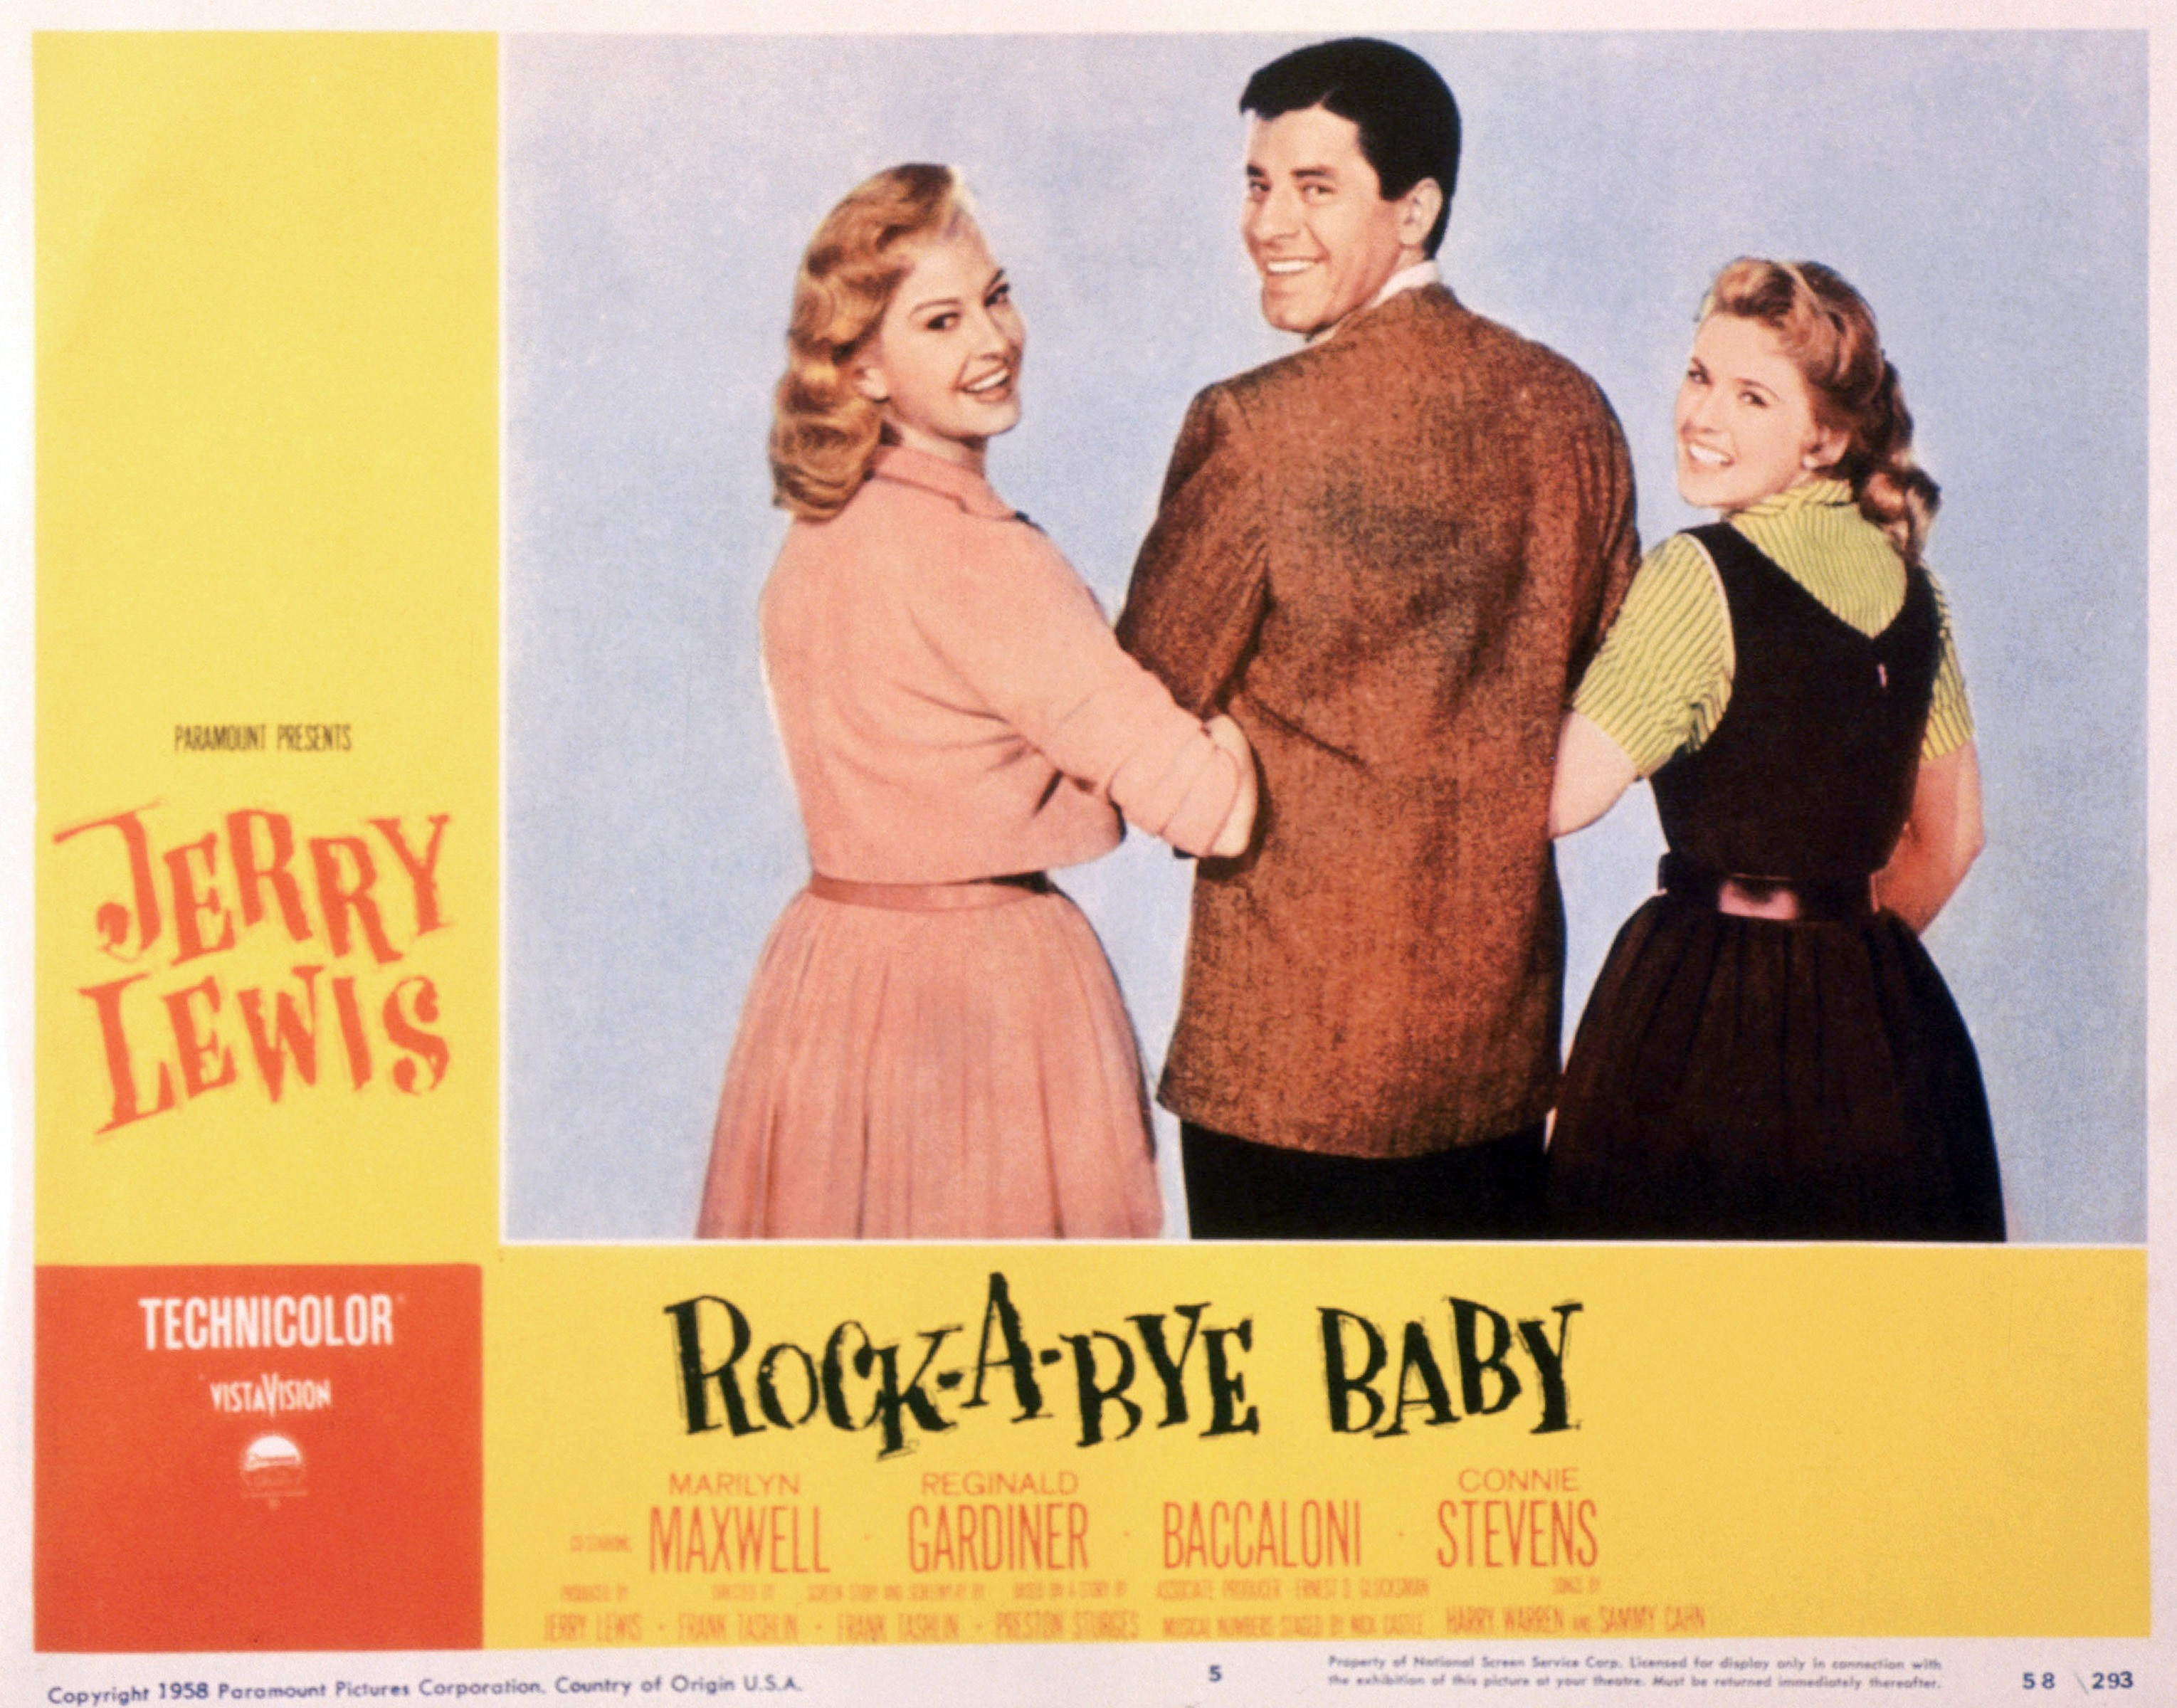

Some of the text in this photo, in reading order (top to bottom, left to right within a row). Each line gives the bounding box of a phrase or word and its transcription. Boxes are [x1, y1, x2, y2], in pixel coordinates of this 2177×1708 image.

[174, 723, 353, 752] PARAMOUNT PRESENTS
[52, 797, 455, 967] JERRY
[77, 964, 451, 1136] LEWIS
[138, 1292, 394, 1351] TECHNICOLOR
[663, 1270, 1584, 1461] ROCK-A-BYE BABY
[668, 1471, 802, 1497] MARILYN
[920, 1469, 1080, 1497] REGINALD
[1457, 1466, 1581, 1494] CONNIE
[648, 1504, 831, 1574] MAXWELL
[907, 1499, 1090, 1574] GARDINER
[1162, 1498, 1362, 1571] BACCALONI
[1435, 1498, 1599, 1569] STEVENS
[542, 1612, 643, 1643] JERRY LEWIS
[678, 1613, 727, 1641] FRANK
[836, 1613, 887, 1642] FRANK
[995, 1610, 1066, 1640] PRESTON
[1445, 1606, 1495, 1634] HARRY
[1502, 1606, 1566, 1633] WARREN
[1598, 1606, 1657, 1633] SAMMY
[1663, 1605, 1707, 1633] CAHN
[1208, 1664, 1223, 1683] 5
[1327, 1655, 1943, 1672] Property of National Screen Service Corp. Licensed for display only in connection with
[46, 1674, 804, 1707] Copyright 1958 Paramount Pictures Corporation. Country of Origin U.S.A.
[1328, 1673, 1942, 1691] the exhibition of this picture at your theatre. Must be returned immediately thereafter.
[2092, 1670, 2134, 1690] 293
